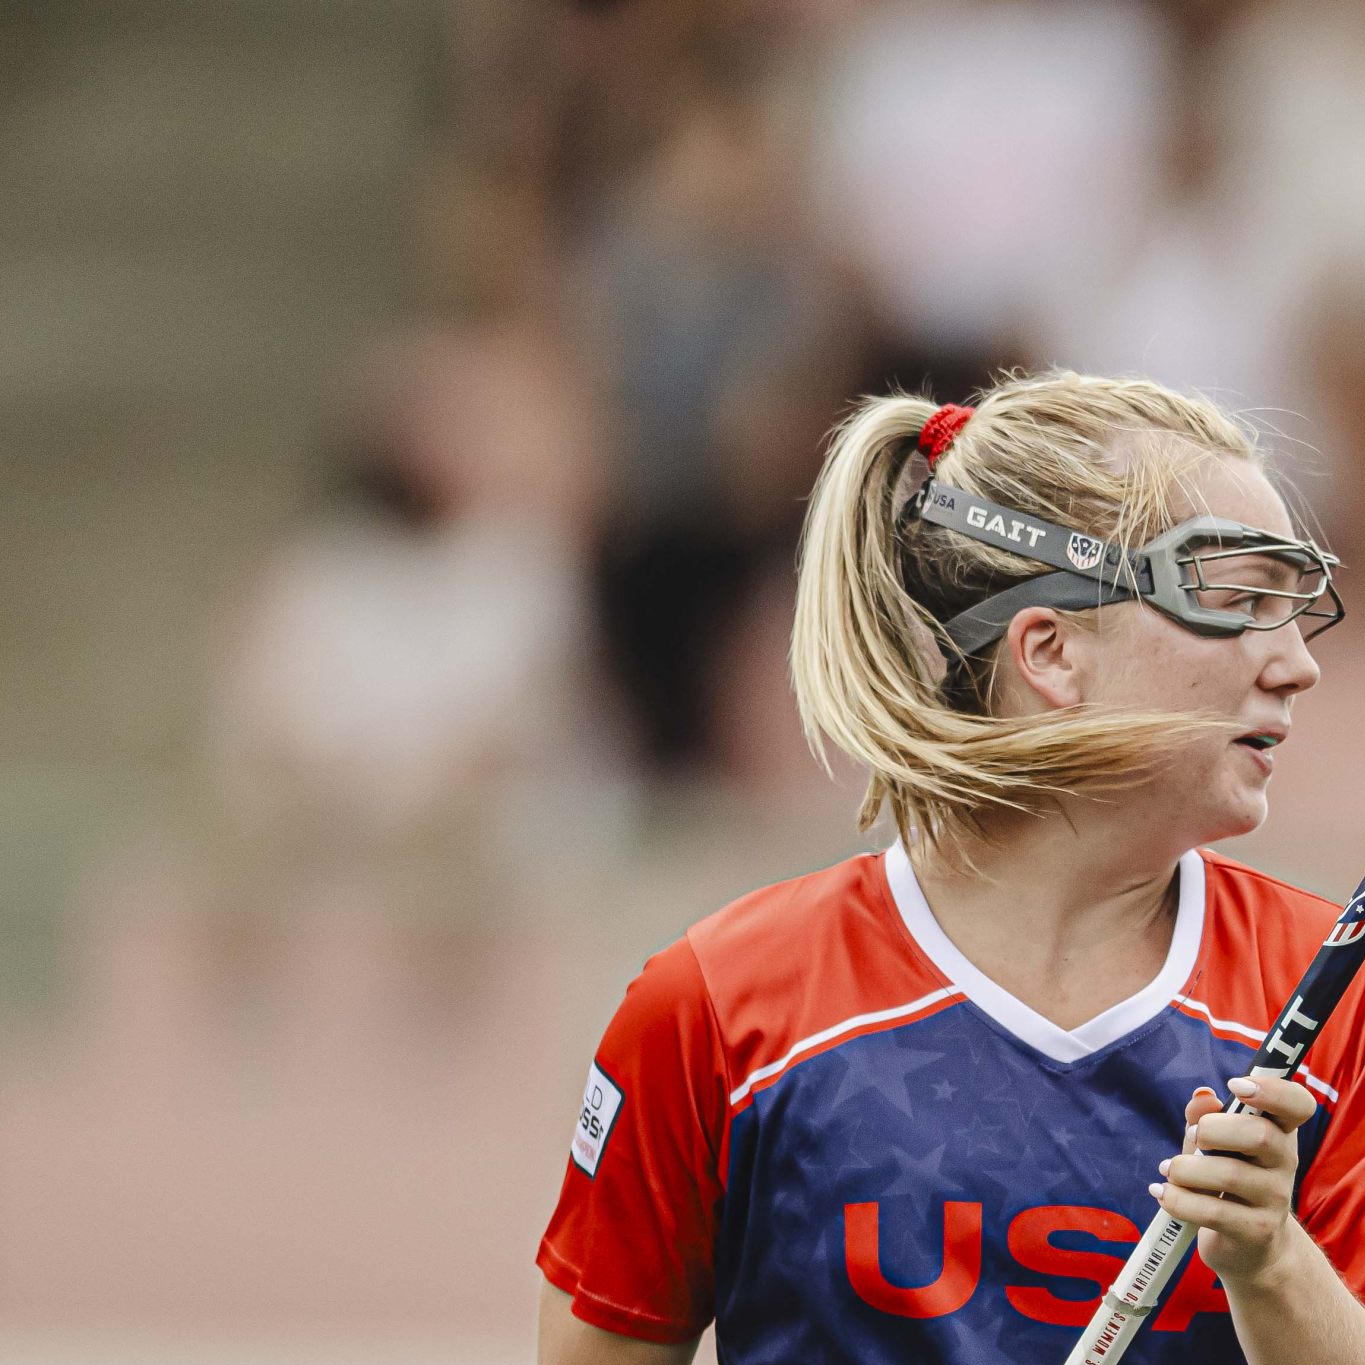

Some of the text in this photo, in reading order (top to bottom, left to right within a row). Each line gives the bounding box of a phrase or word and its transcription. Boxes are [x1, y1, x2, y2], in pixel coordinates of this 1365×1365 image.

[966, 504, 1047, 548] GAIT
[1092, 1311, 1126, 1356] WOMEN'S
[1132, 1249, 1167, 1292] NATIONAL
[1159, 1220, 1183, 1249] TEAM
